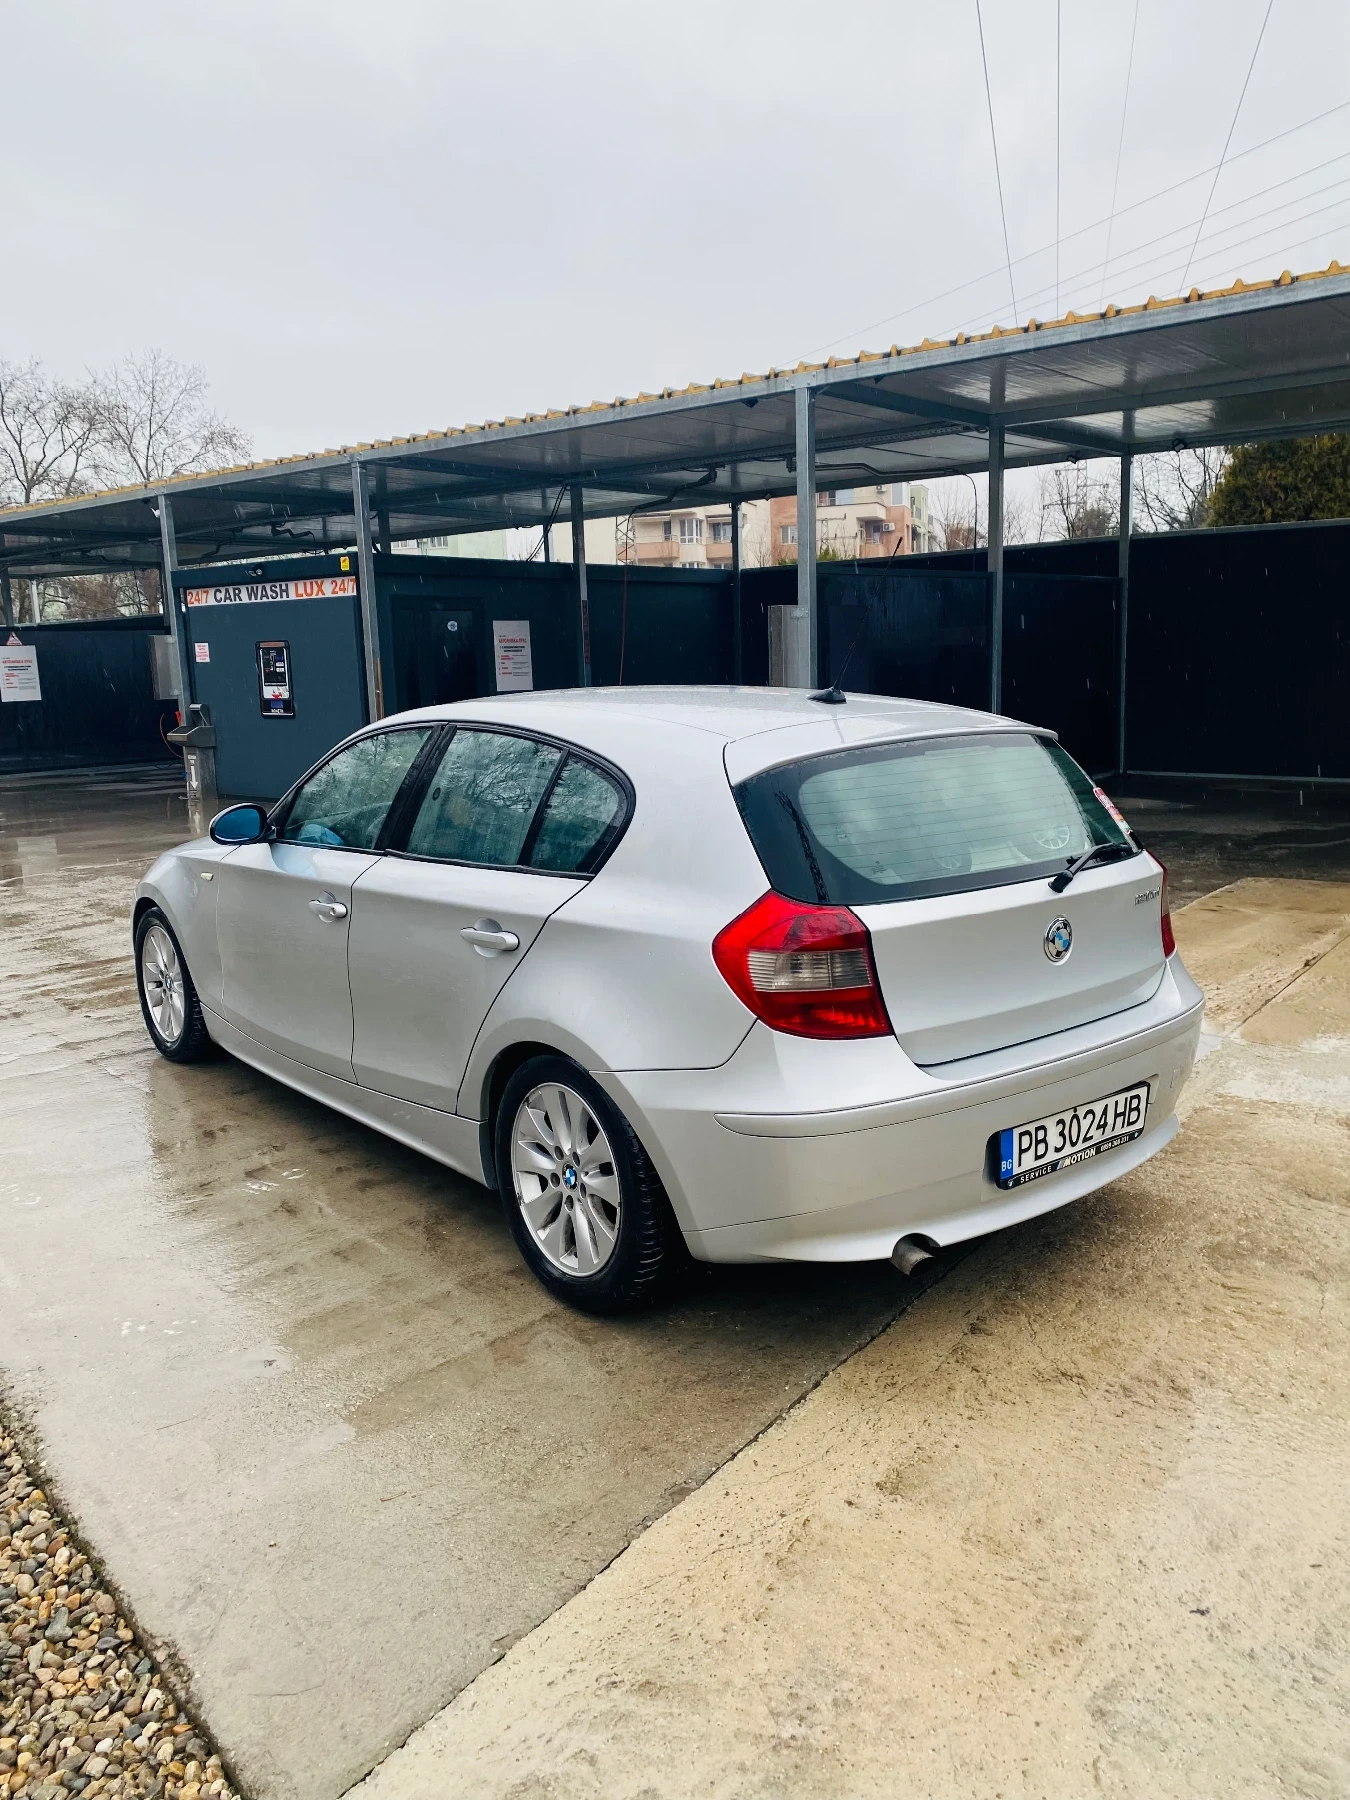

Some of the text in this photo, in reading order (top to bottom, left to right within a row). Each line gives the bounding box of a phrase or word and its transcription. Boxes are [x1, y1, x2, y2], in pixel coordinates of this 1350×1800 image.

[187, 578, 357, 605] 24/7 CAR WASH LUX 24/7
[1018, 1093, 1142, 1167] PB 3024 HB
[1001, 1159, 1013, 1172] BG
[1020, 1165, 1052, 1184] SERVICE
[1063, 1147, 1096, 1168] MOTION
